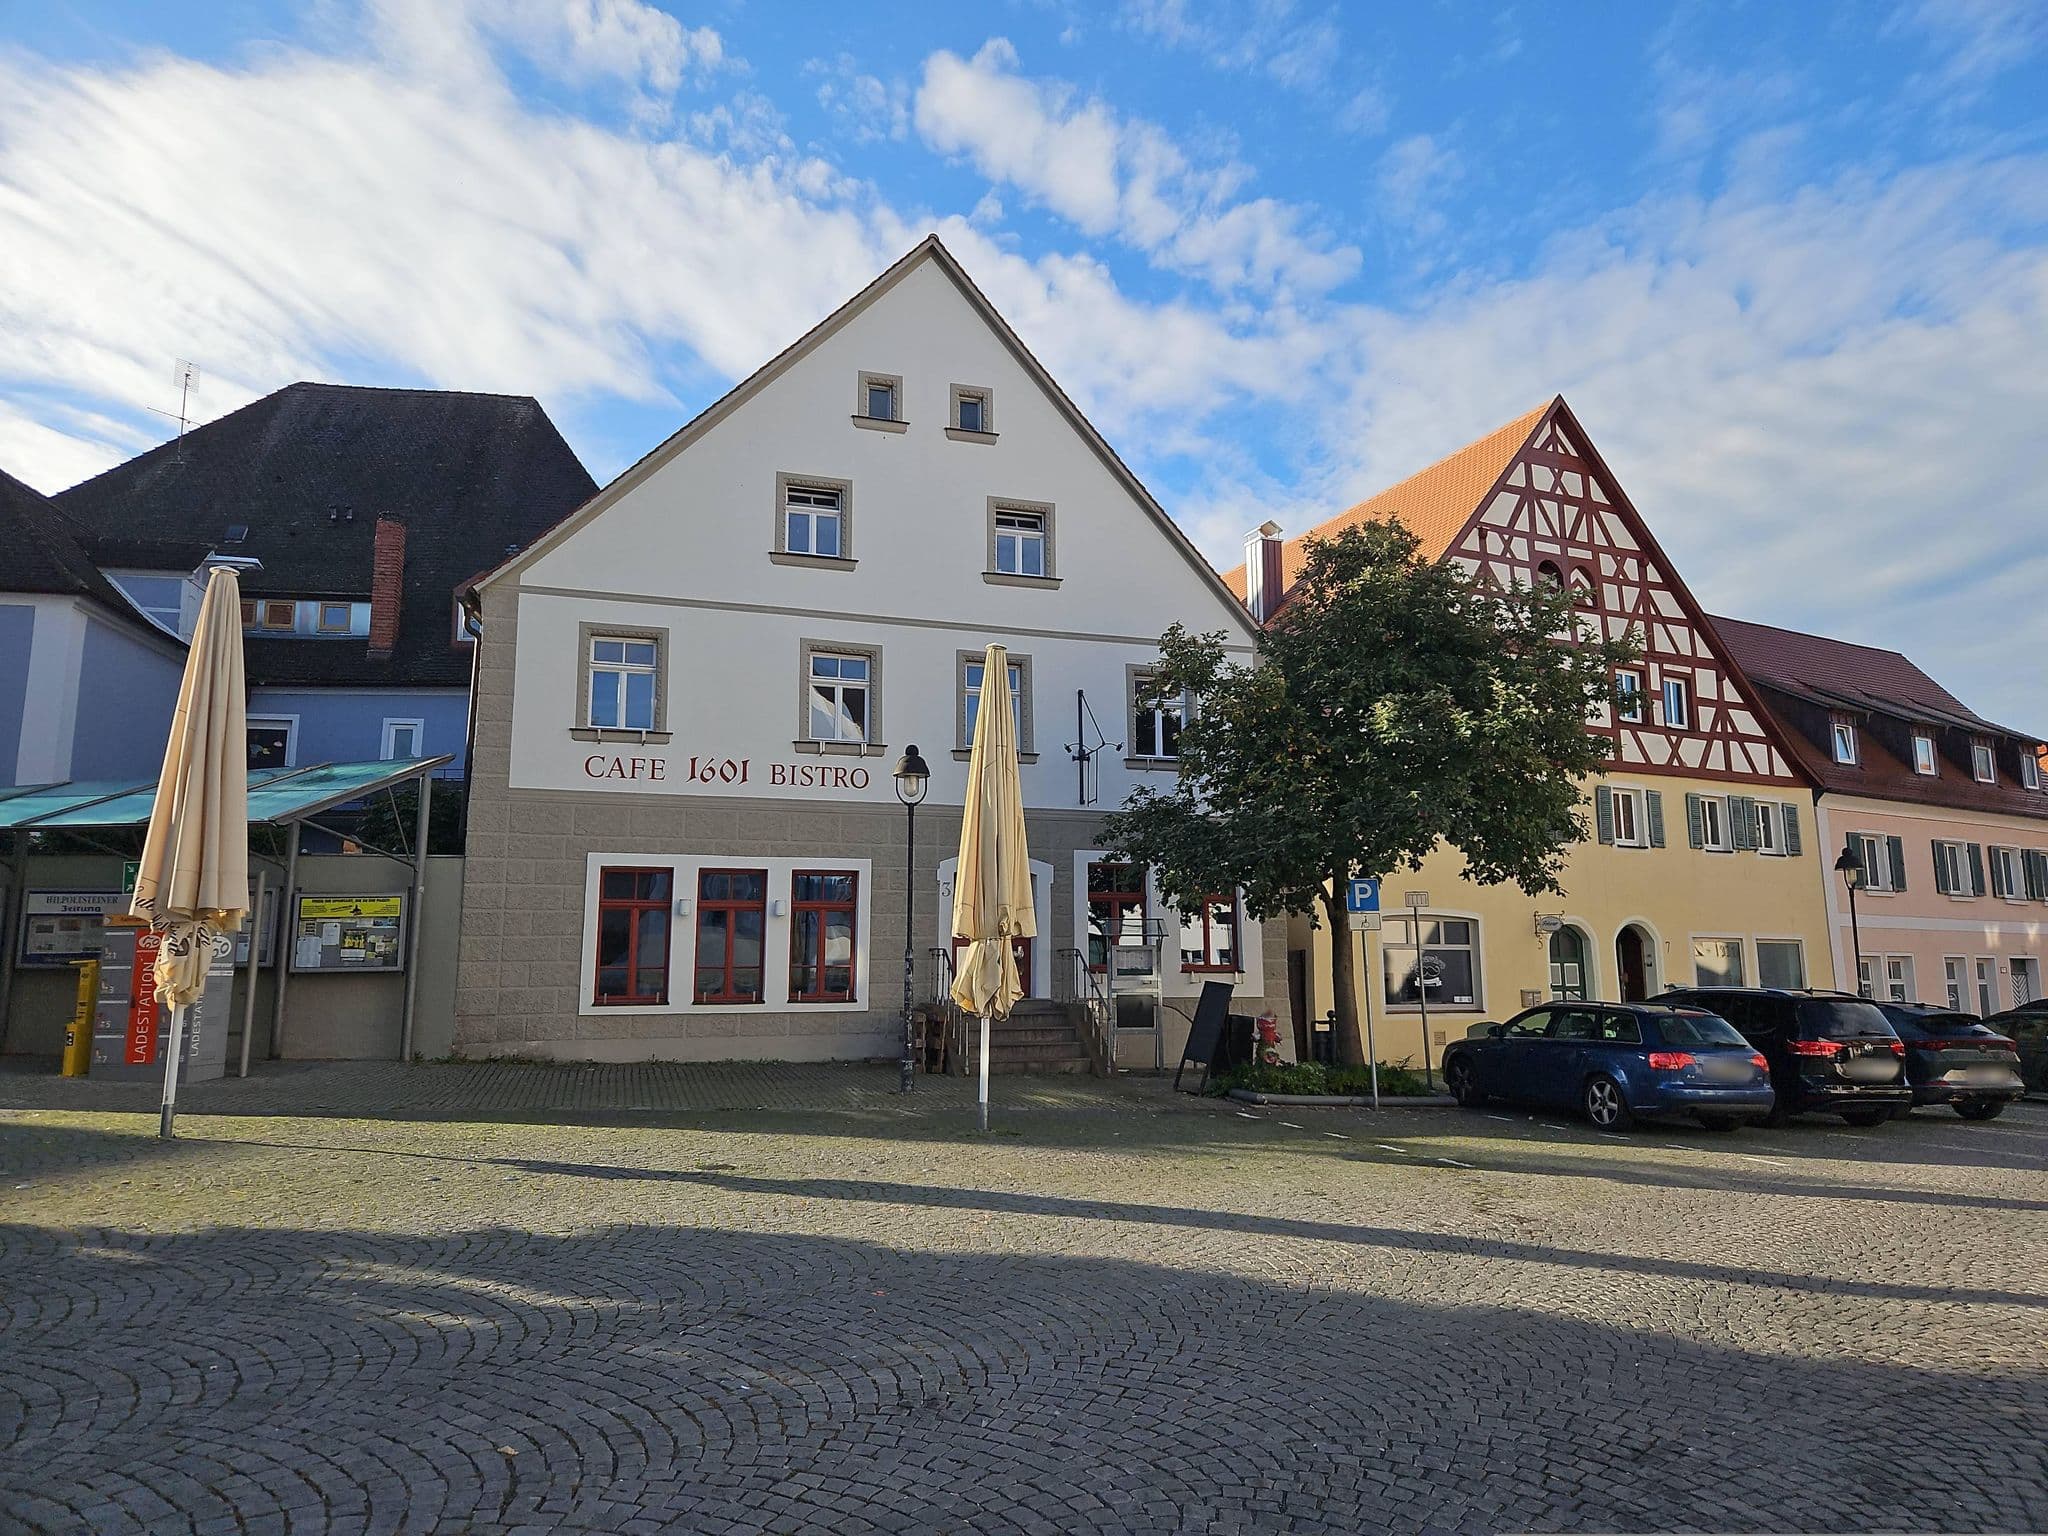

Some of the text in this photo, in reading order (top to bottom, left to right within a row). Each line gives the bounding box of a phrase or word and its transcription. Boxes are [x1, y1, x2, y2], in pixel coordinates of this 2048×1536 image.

[583, 755, 871, 790] CAFE 1601 BISTRO
[940, 881, 952, 897] 3
[1354, 883, 1372, 908] P
[1664, 941, 1671, 953] 7
[133, 961, 155, 1064] LADESTATION
